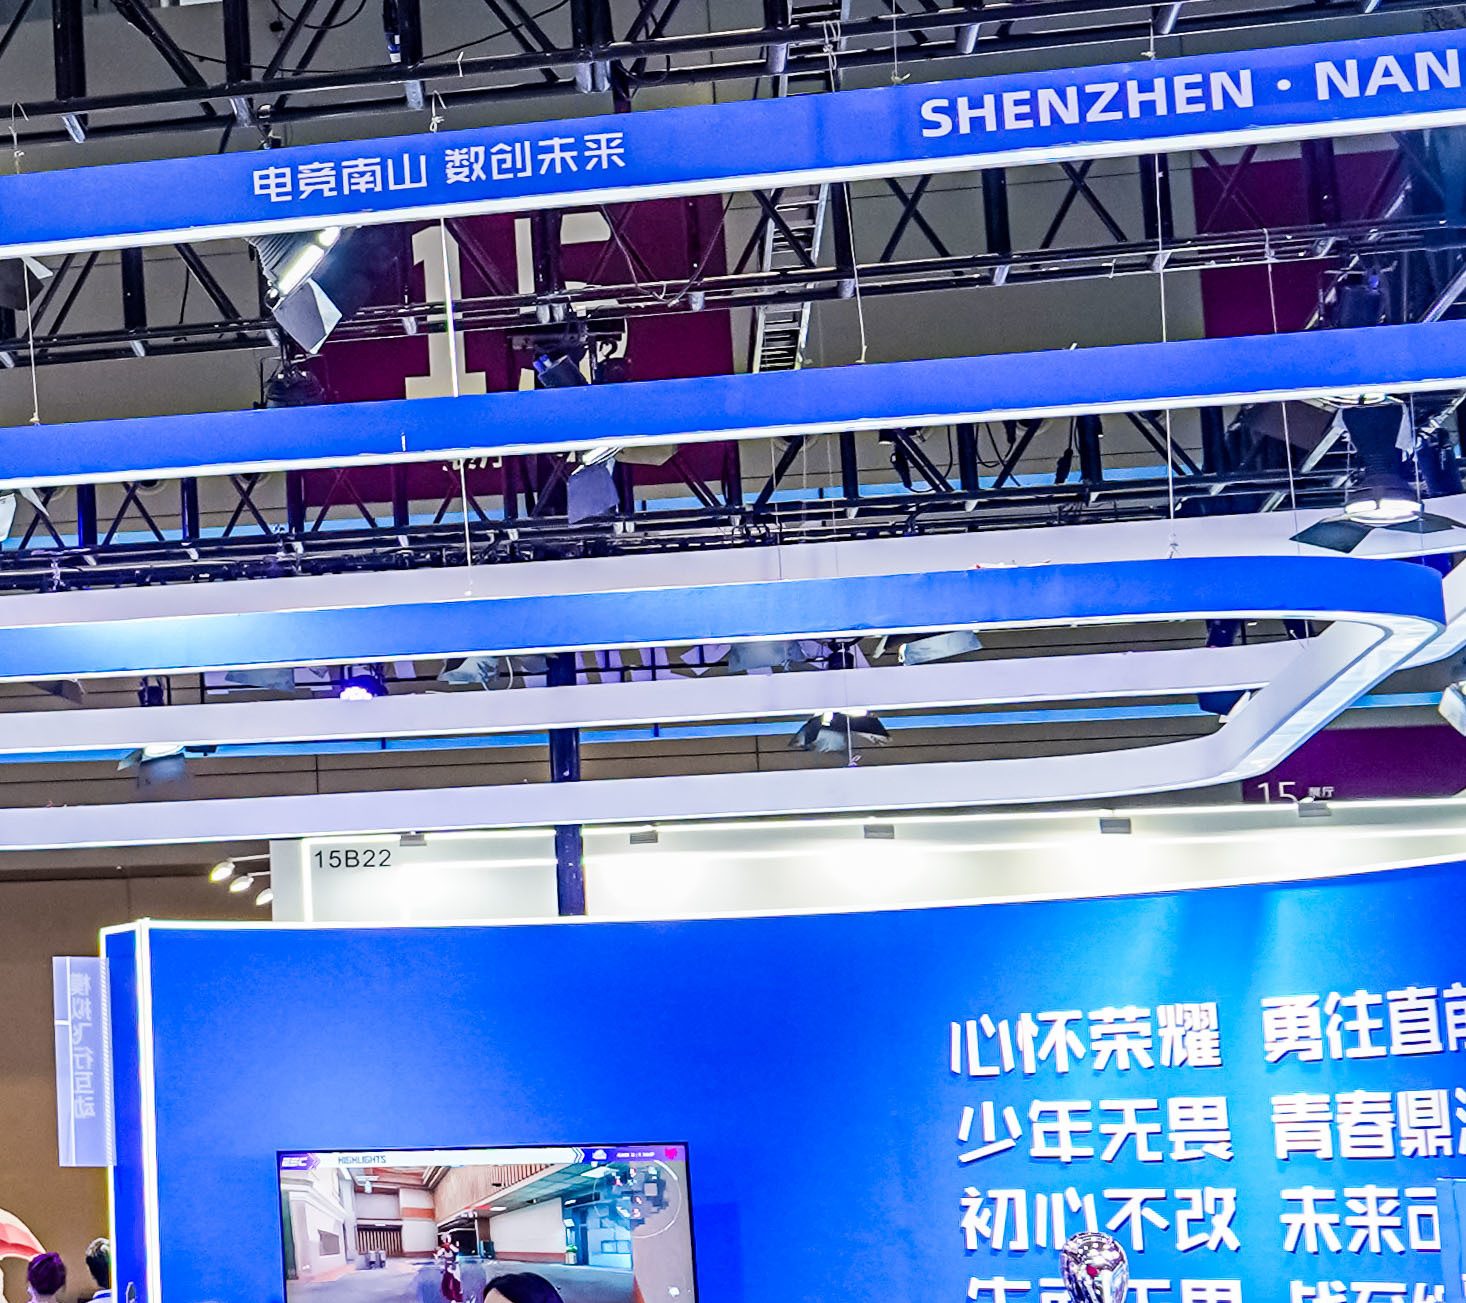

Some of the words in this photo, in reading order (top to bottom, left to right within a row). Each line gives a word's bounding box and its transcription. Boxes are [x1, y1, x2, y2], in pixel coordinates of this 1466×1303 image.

[920, 70, 1255, 139] SHENZHEN
[251, 150, 429, 204] 电竞南山
[442, 131, 628, 187] 数创未来
[314, 849, 392, 868] 15B22
[949, 1001, 1222, 1077] 心怀荣耀
[957, 1094, 1235, 1165] 少年无畏
[1269, 1090, 1466, 1162] 青春鼎
[959, 1186, 1241, 1253] 初心不改
